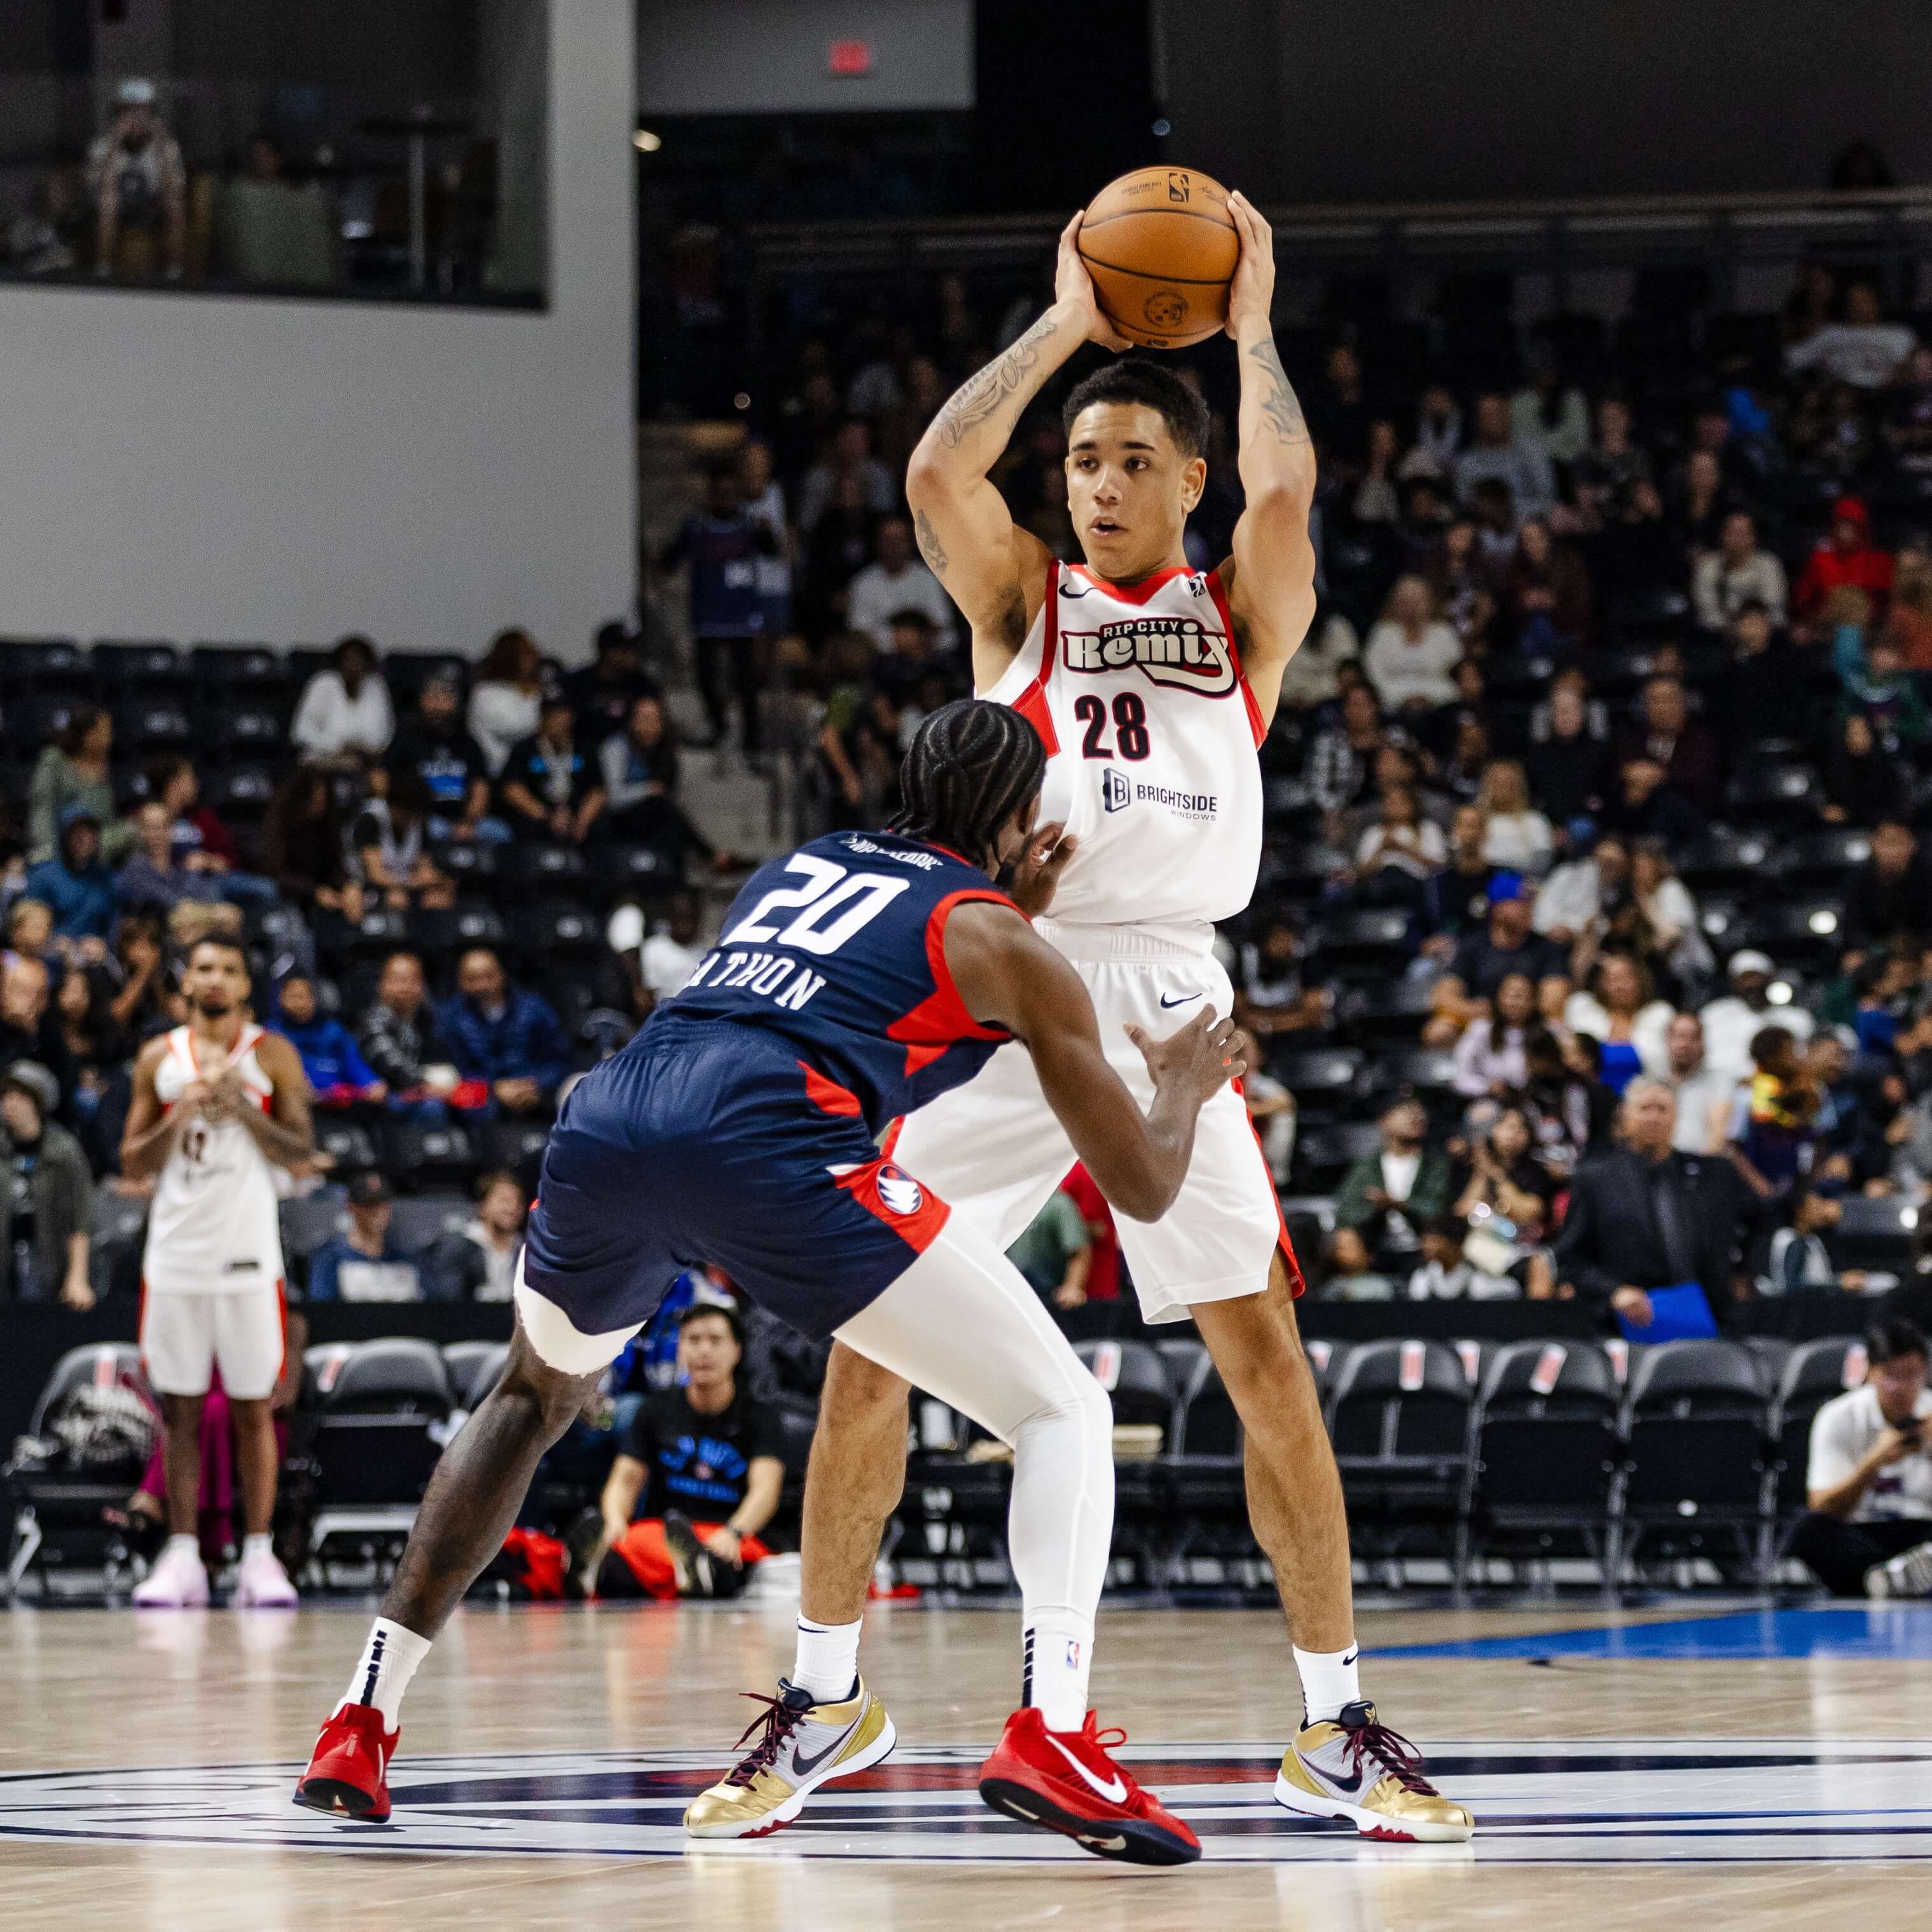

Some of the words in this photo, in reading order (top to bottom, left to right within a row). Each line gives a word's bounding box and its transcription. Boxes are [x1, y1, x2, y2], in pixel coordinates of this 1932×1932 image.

[1103, 623, 1133, 637] RIP
[1137, 621, 1179, 632] CITY
[1065, 623, 1234, 693] Remix
[1074, 691, 1150, 762] 28
[1137, 784, 1217, 812] BRIGHTSIDE
[1170, 808, 1217, 821] WINDOWS
[720, 853, 911, 955] 20
